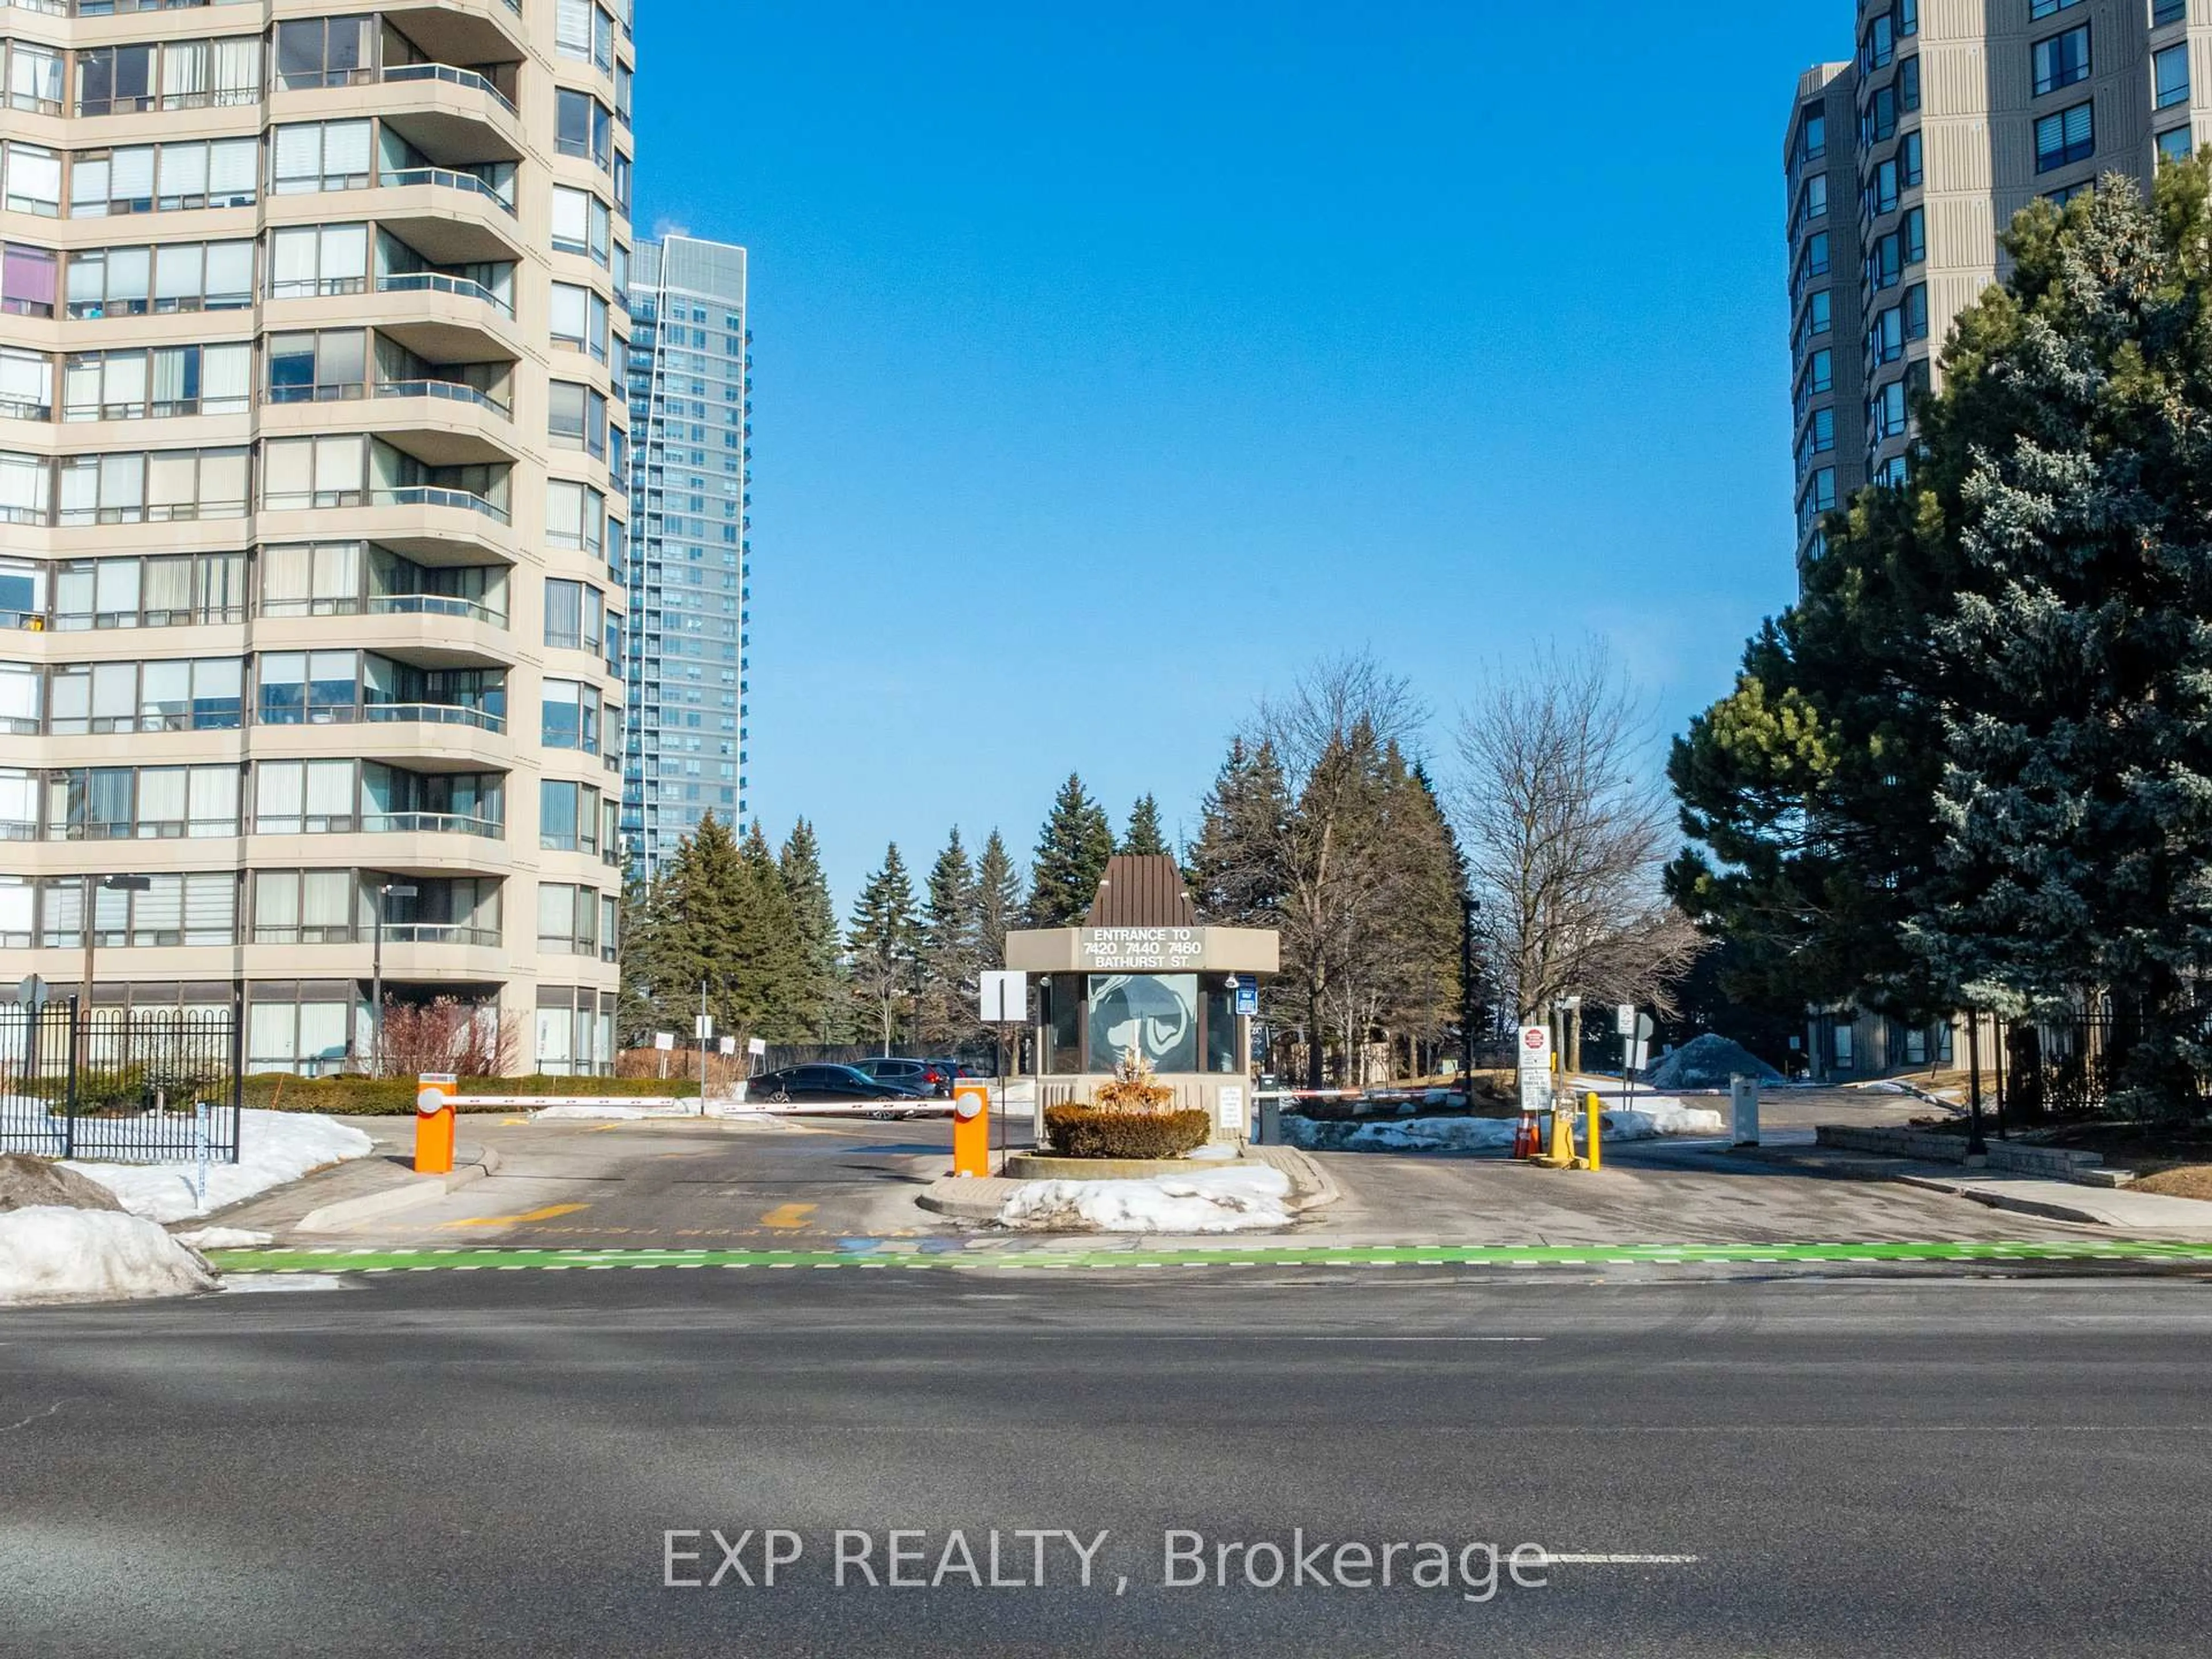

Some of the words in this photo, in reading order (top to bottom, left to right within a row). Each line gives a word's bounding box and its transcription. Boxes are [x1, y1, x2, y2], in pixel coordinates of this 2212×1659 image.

[1094, 929, 1166, 941] ENTRANCE
[1172, 929, 1191, 941] TO
[1083, 942, 1118, 955] 7420
[1124, 942, 1160, 955] 7440
[1167, 942, 1202, 955] 7460
[1094, 955, 1166, 968] BATHURST
[1170, 955, 1190, 968] ST.
